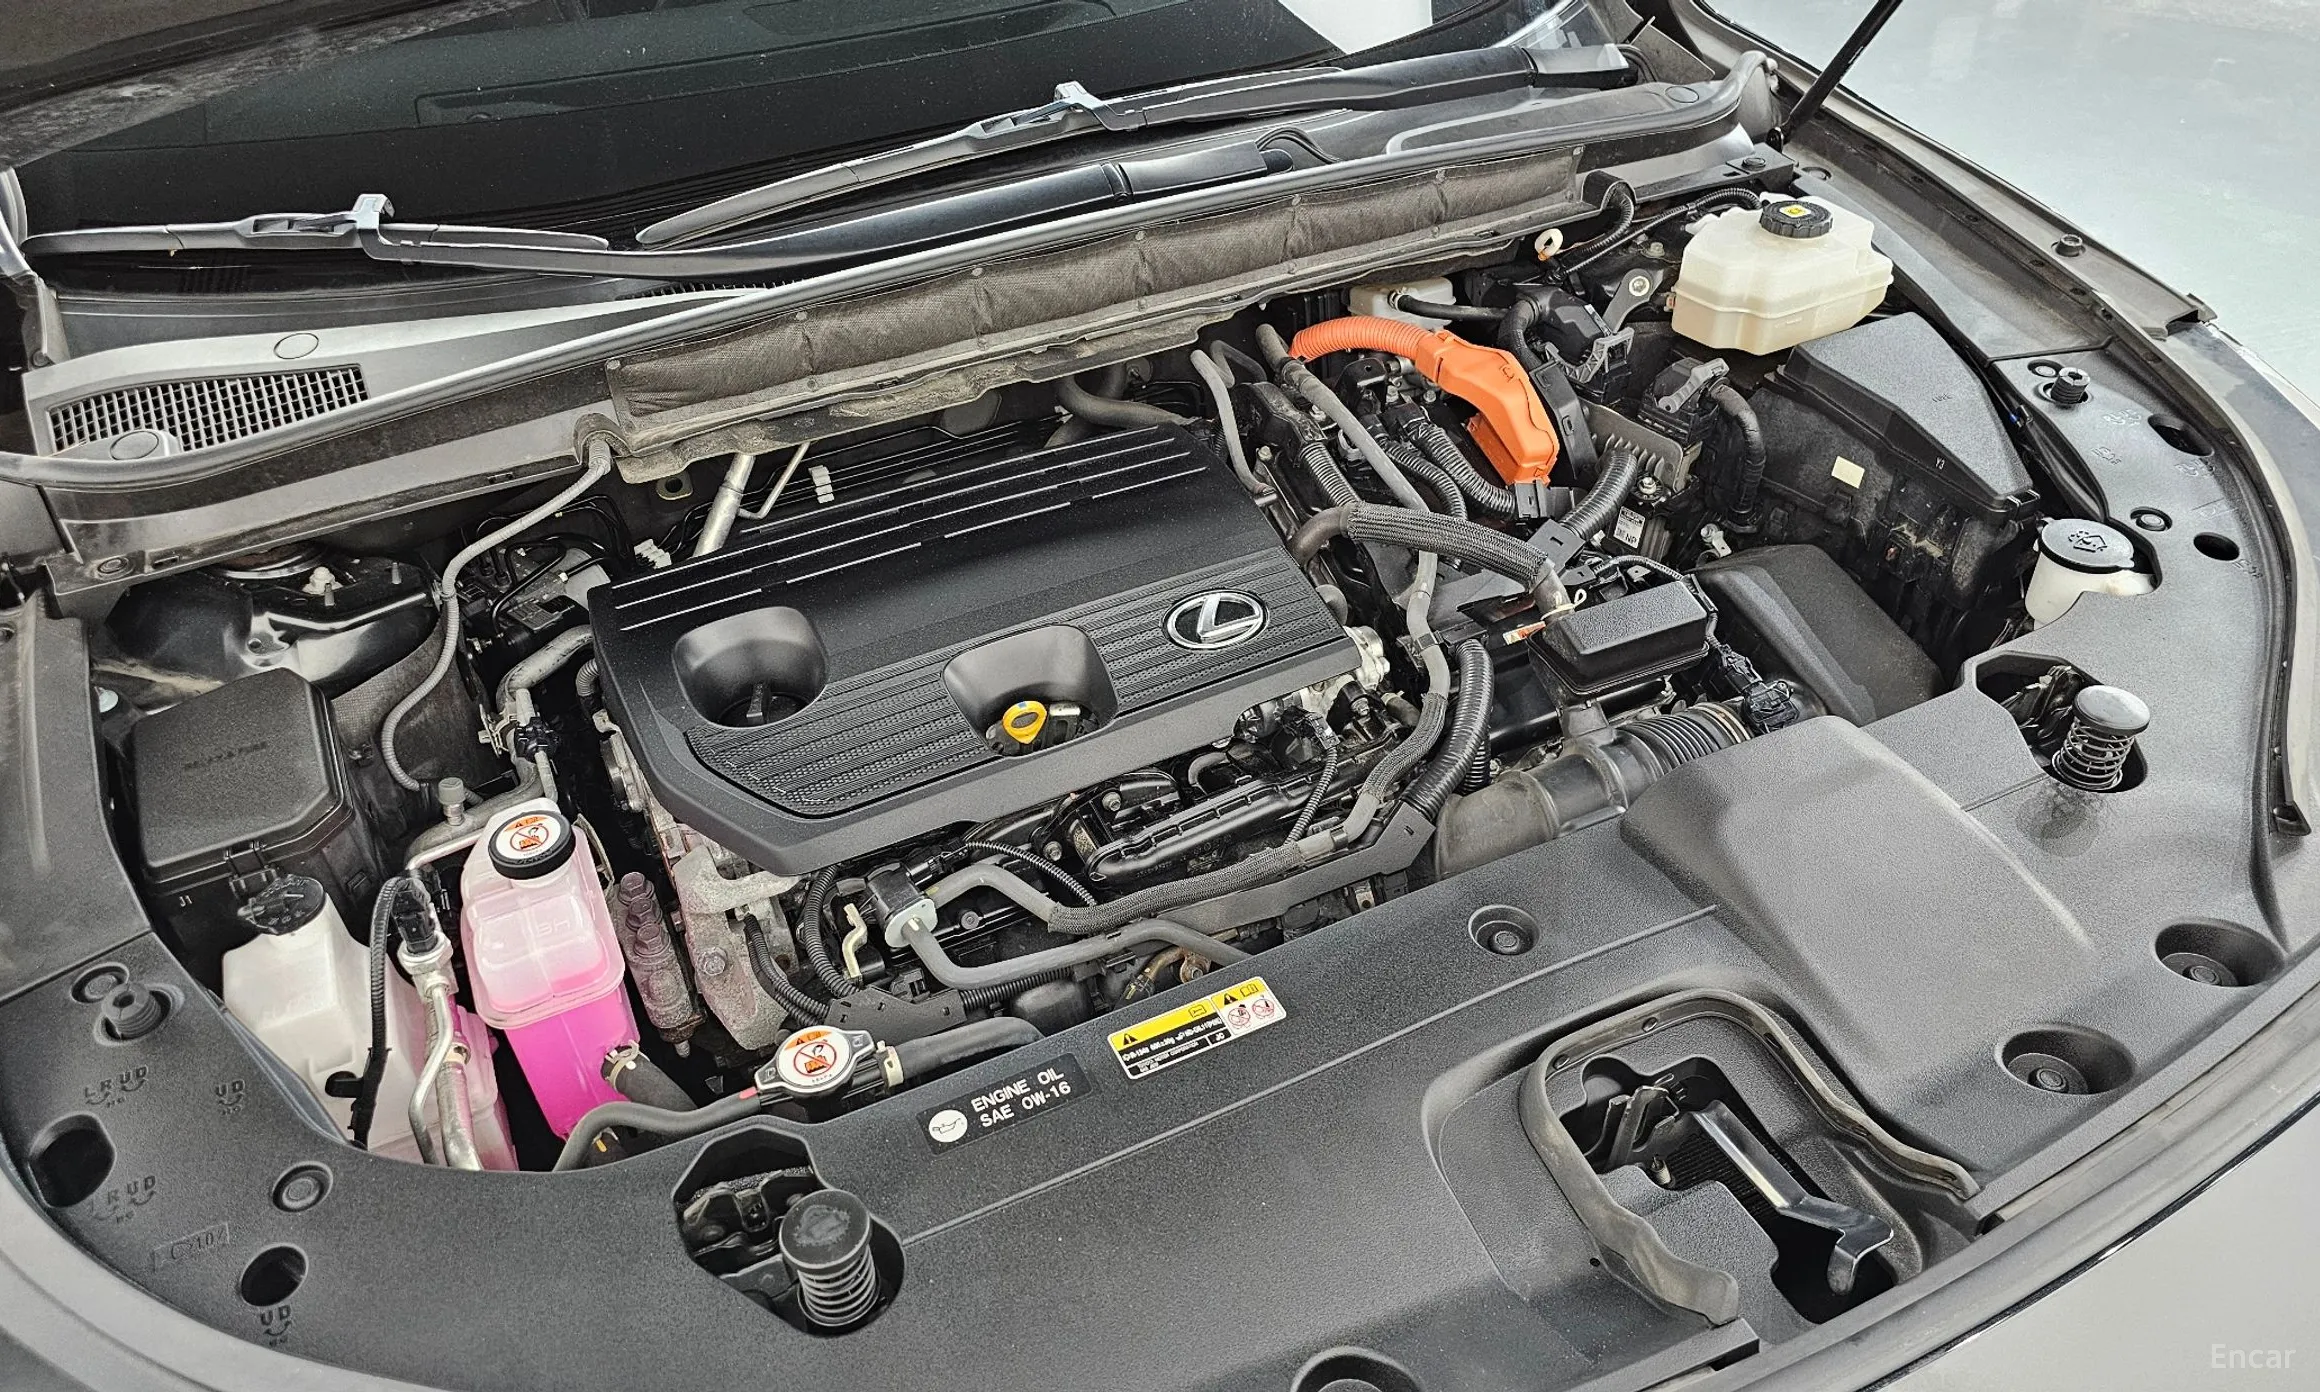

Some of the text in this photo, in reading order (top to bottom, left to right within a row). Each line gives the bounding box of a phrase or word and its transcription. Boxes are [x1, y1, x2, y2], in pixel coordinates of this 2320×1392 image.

[971, 1068, 1064, 1112] ENGINE OIL
[980, 1081, 1071, 1127] SAE 0W-16
